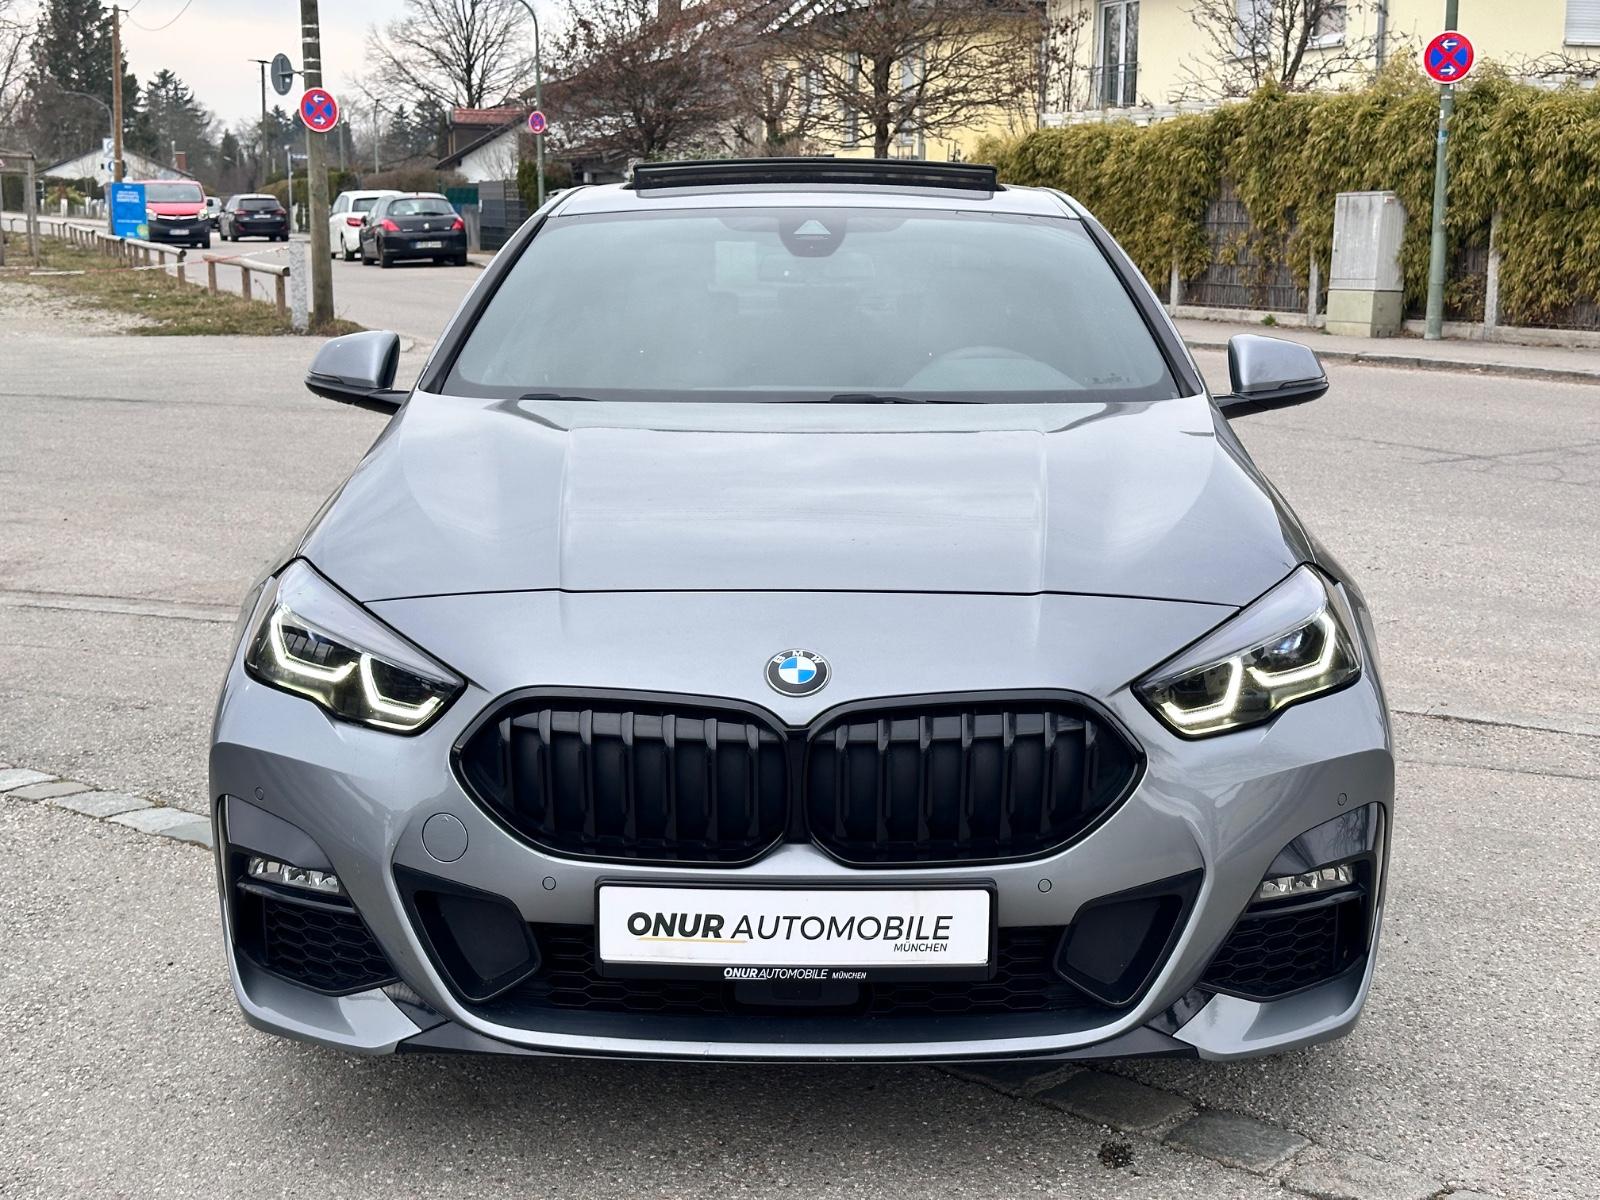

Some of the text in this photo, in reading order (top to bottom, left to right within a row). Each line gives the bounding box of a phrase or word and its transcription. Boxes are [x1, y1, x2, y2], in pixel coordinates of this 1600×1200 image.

[771, 649, 825, 663] BMW
[627, 911, 954, 941] ONUR AUTOMOBILE
[893, 941, 948, 952] MÜNCHEN
[723, 967, 867, 980] ONUR AUTOMOBILE MÜNCHEN
